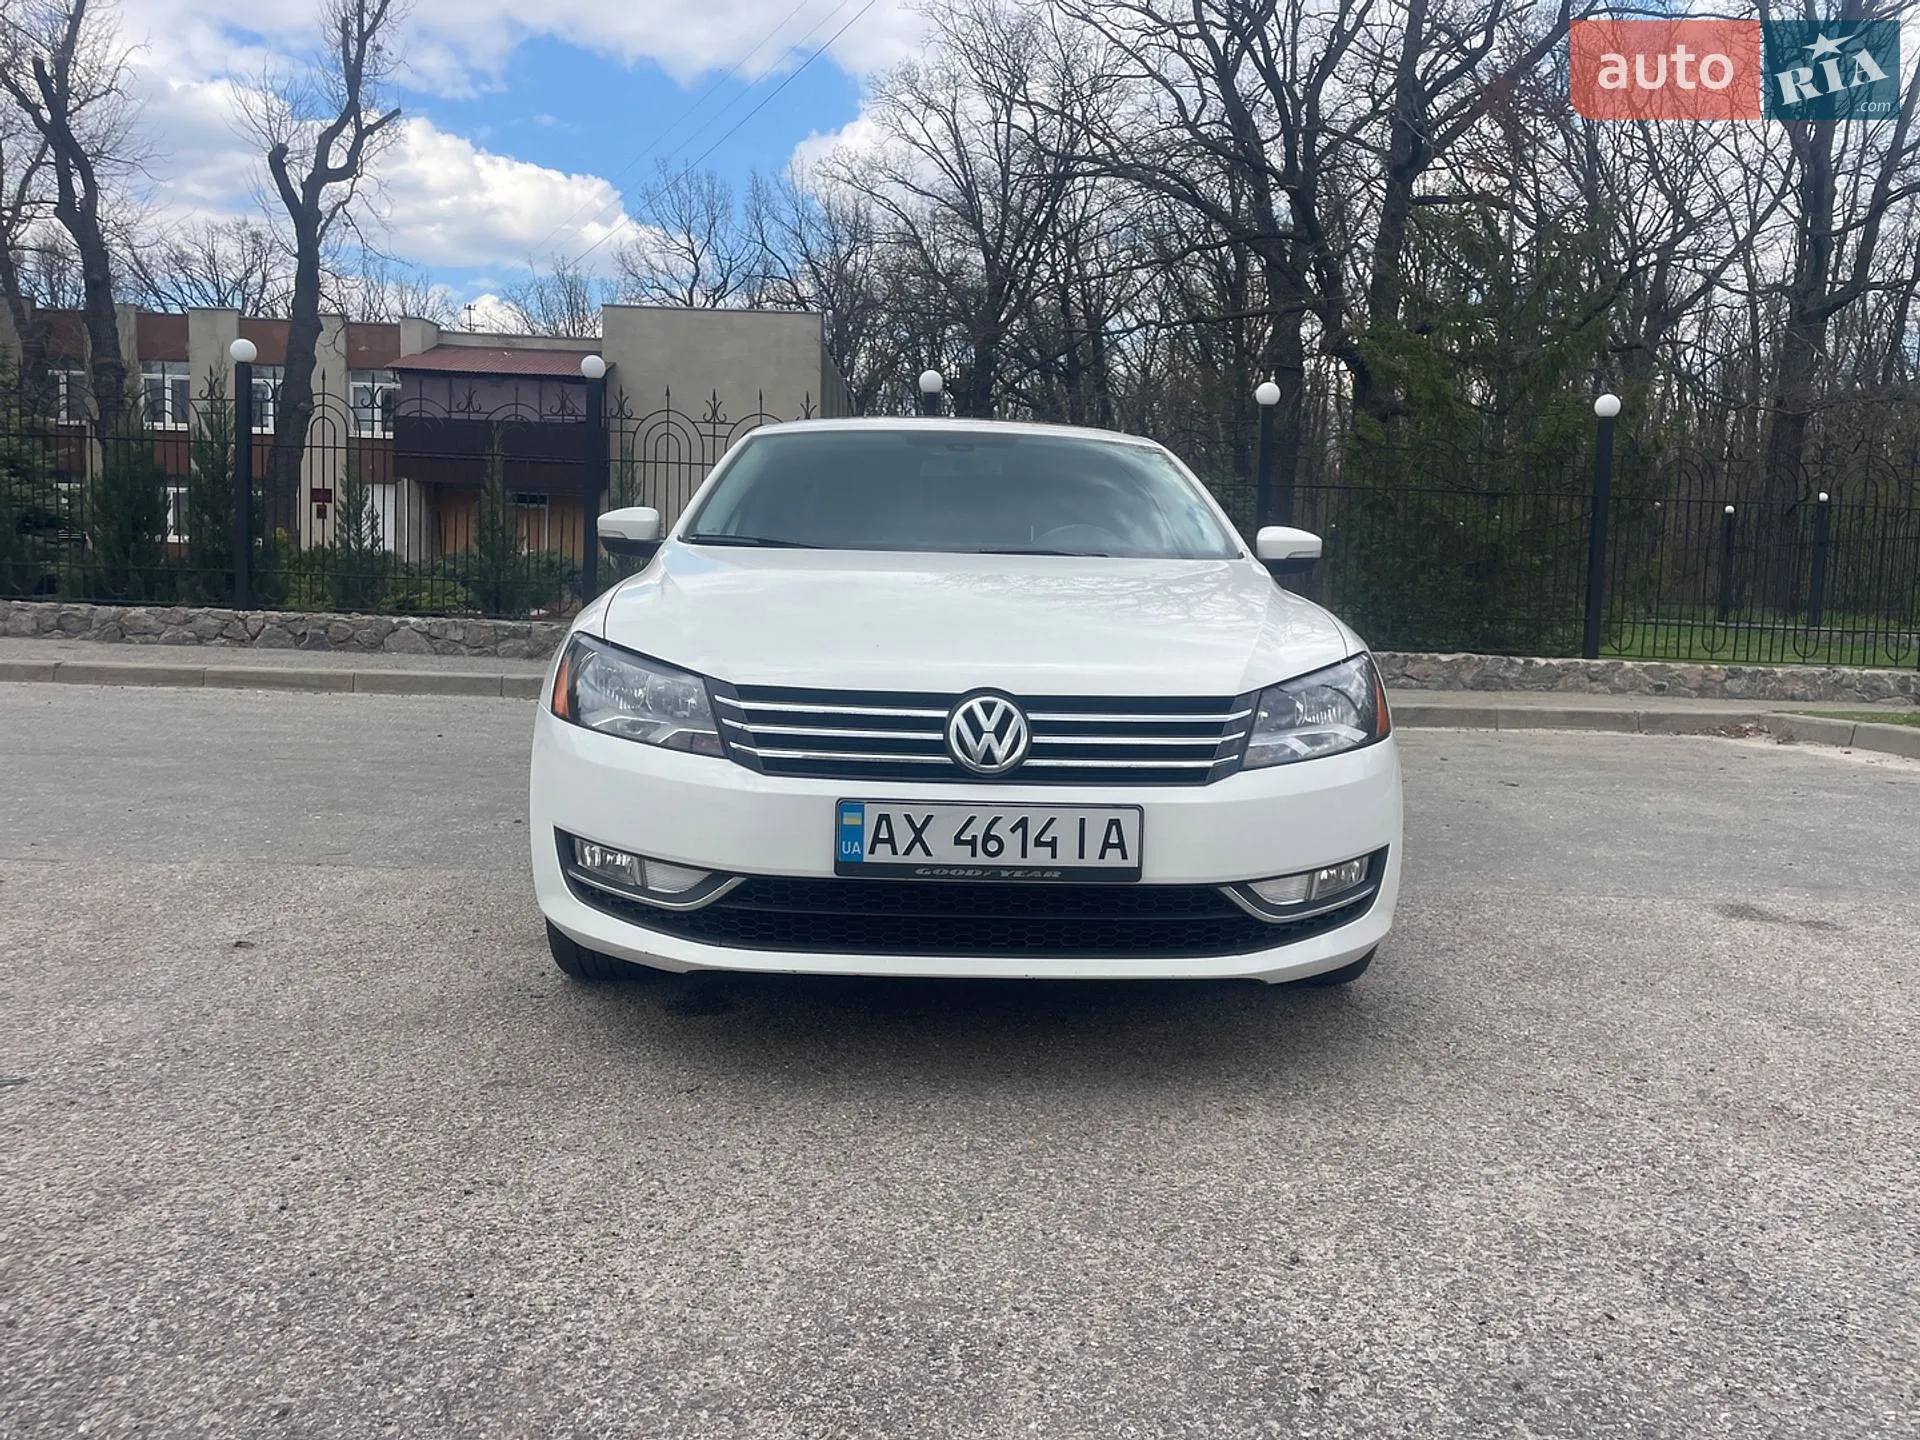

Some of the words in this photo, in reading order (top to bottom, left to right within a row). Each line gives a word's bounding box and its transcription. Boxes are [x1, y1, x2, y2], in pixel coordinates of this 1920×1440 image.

[842, 841, 861, 855] UA
[868, 813, 934, 857] AX
[953, 815, 1057, 859] 4614
[1078, 817, 1128, 860] IA
